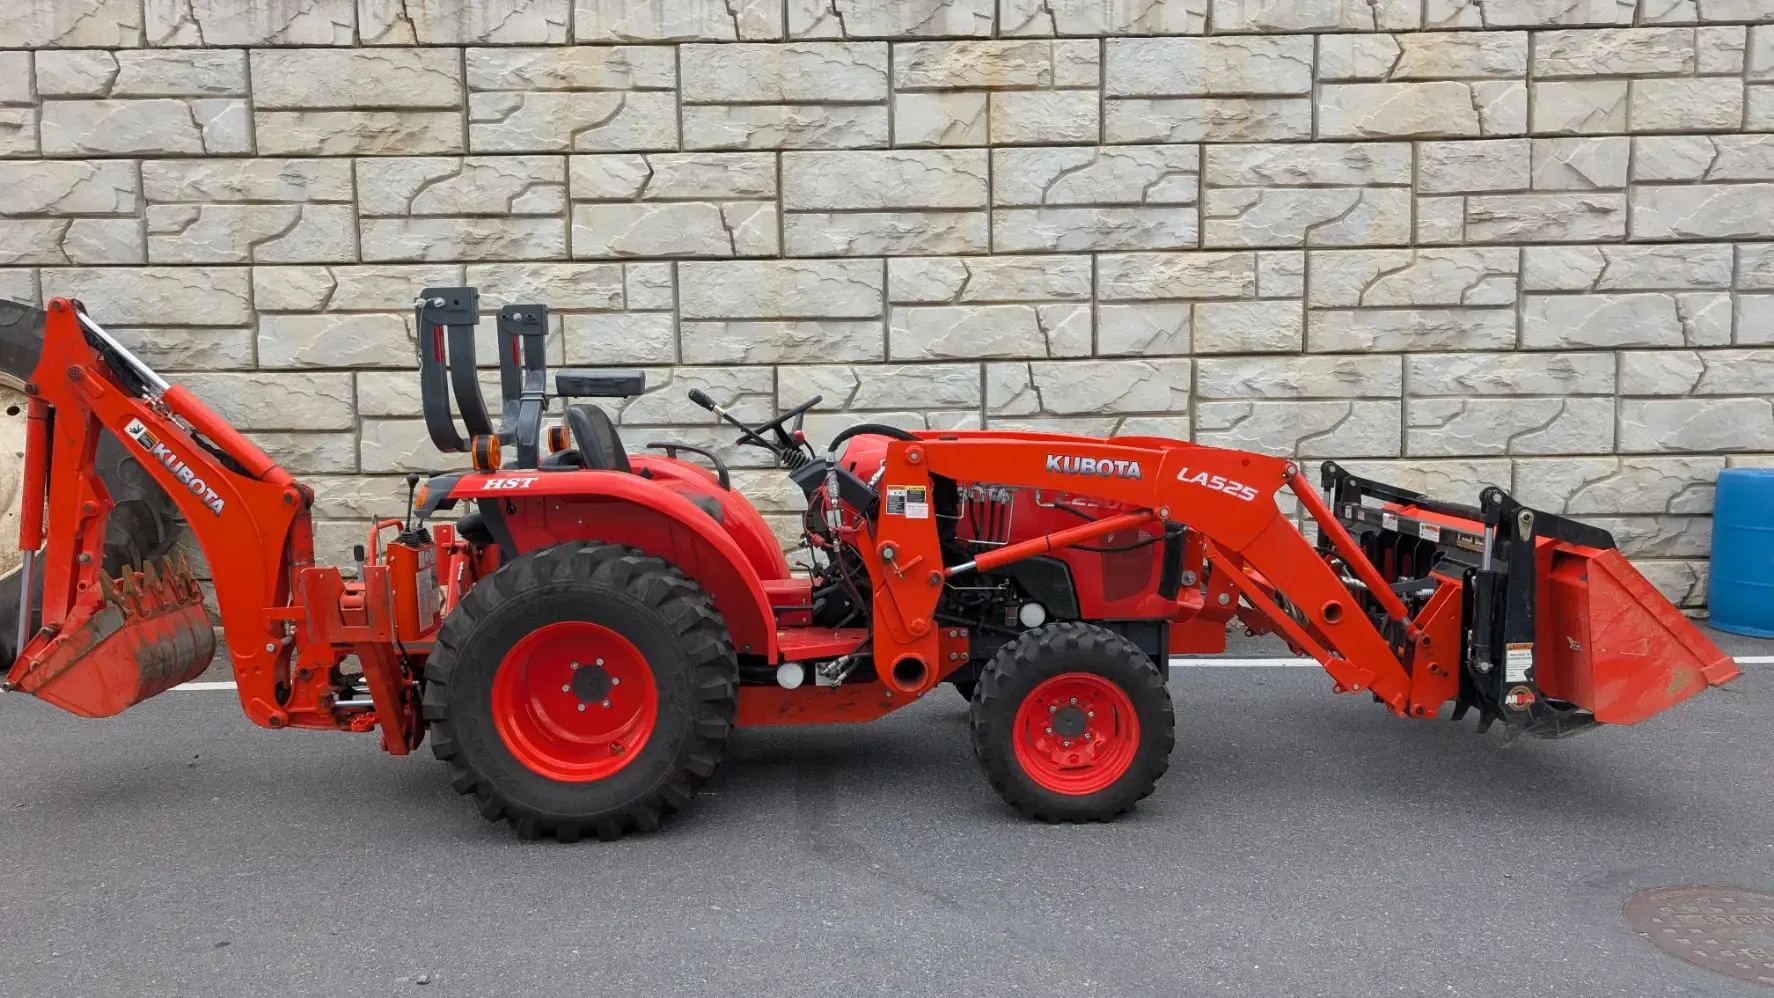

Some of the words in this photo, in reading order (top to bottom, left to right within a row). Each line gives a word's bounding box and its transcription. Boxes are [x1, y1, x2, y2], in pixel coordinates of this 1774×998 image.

[152, 442, 225, 517] KUBOTA
[1046, 454, 1142, 480] KUBOTA
[481, 477, 539, 490] HST
[1177, 467, 1259, 501] LA525
